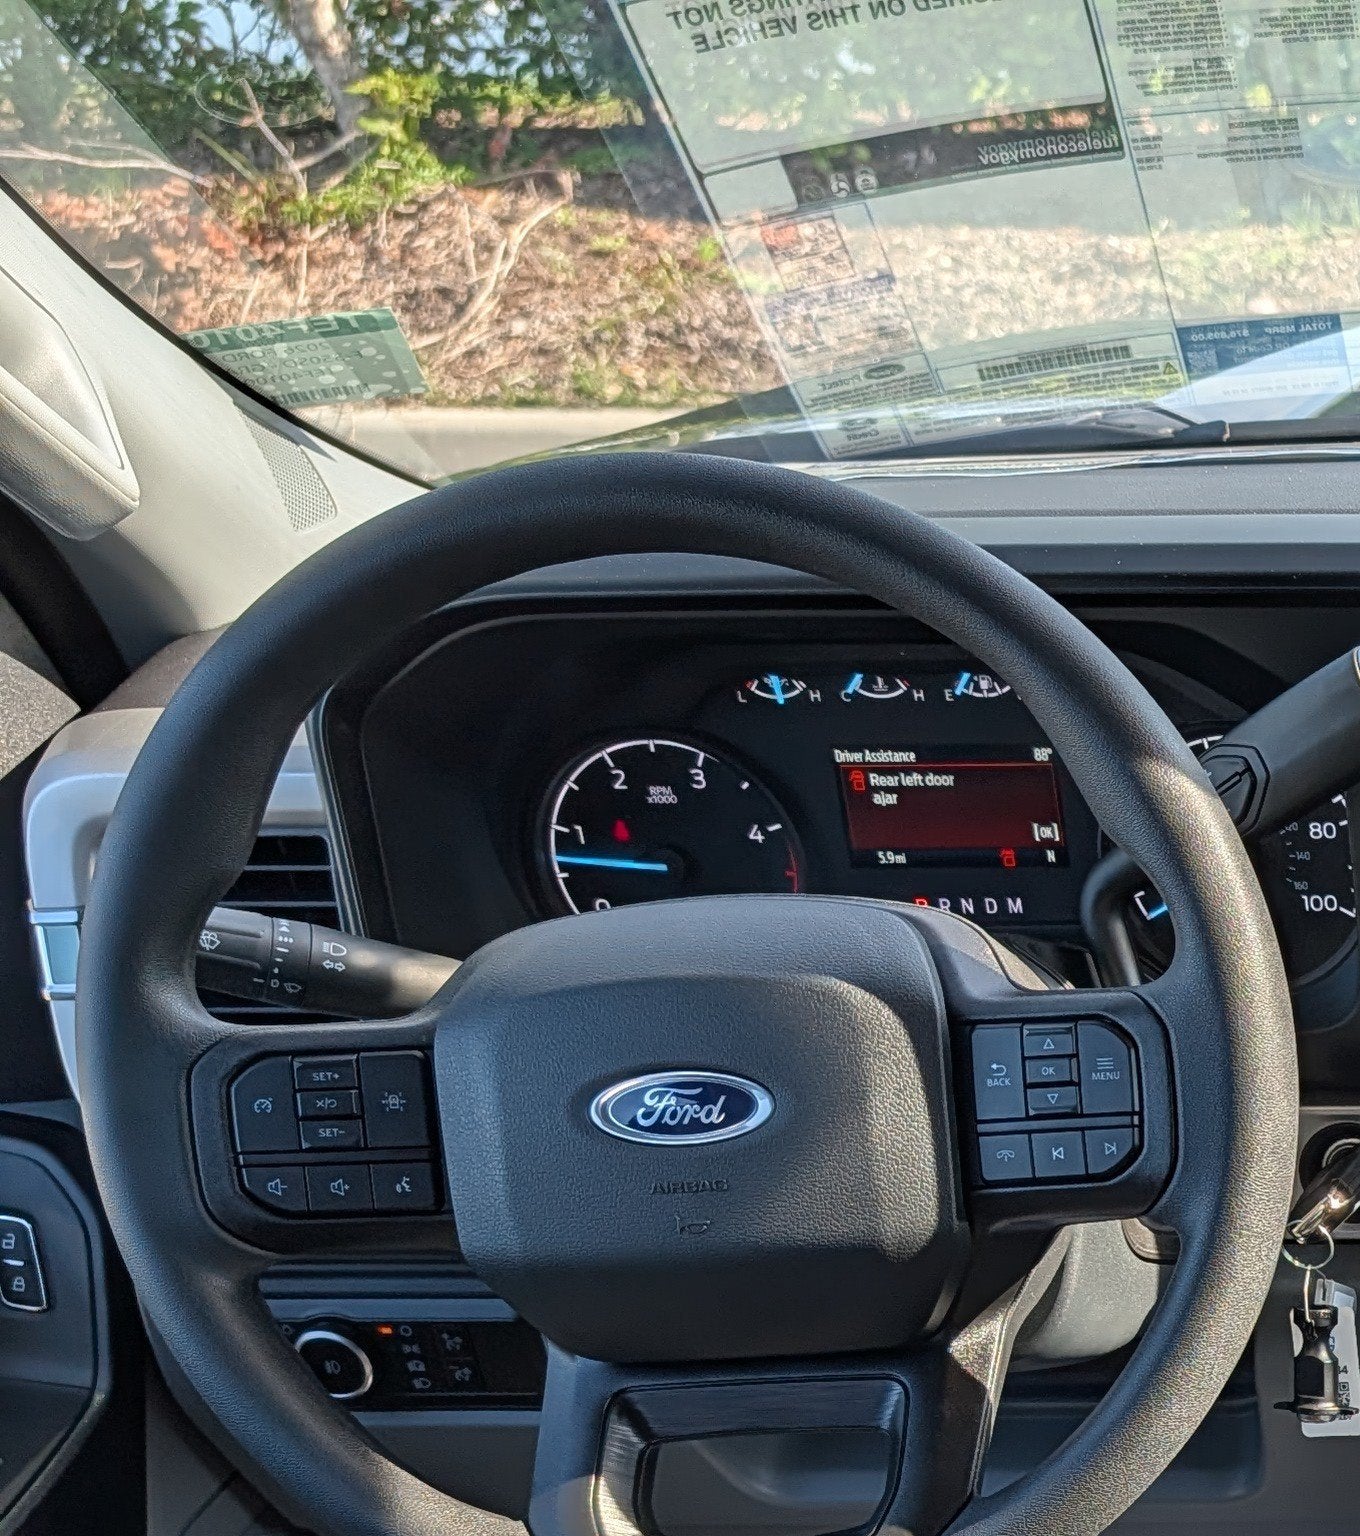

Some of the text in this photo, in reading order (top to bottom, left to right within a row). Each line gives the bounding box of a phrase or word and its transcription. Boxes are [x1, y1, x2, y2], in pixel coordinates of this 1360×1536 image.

[810, 689, 822, 703] H
[912, 689, 926, 703] H
[833, 749, 864, 764] Driver
[865, 750, 917, 764] Assistance
[611, 769, 707, 790] 2 3
[869, 772, 956, 788] Rear left door
[648, 786, 674, 797] RPM
[872, 792, 899, 808] ajar
[572, 824, 767, 845] 1 4
[1309, 821, 1338, 840] 80
[1045, 850, 1057, 864] N
[938, 898, 952, 912] R
[960, 898, 976, 914] N
[984, 898, 999, 914] D
[1007, 898, 1025, 914] M
[1301, 894, 1339, 912] 100
[1041, 1066, 1057, 1076] OK
[1090, 1070, 1121, 1083] MENU
[985, 1077, 1012, 1089] BACK
[636, 1086, 727, 1128] Ford
[649, 1178, 730, 1196] AIRBAG
